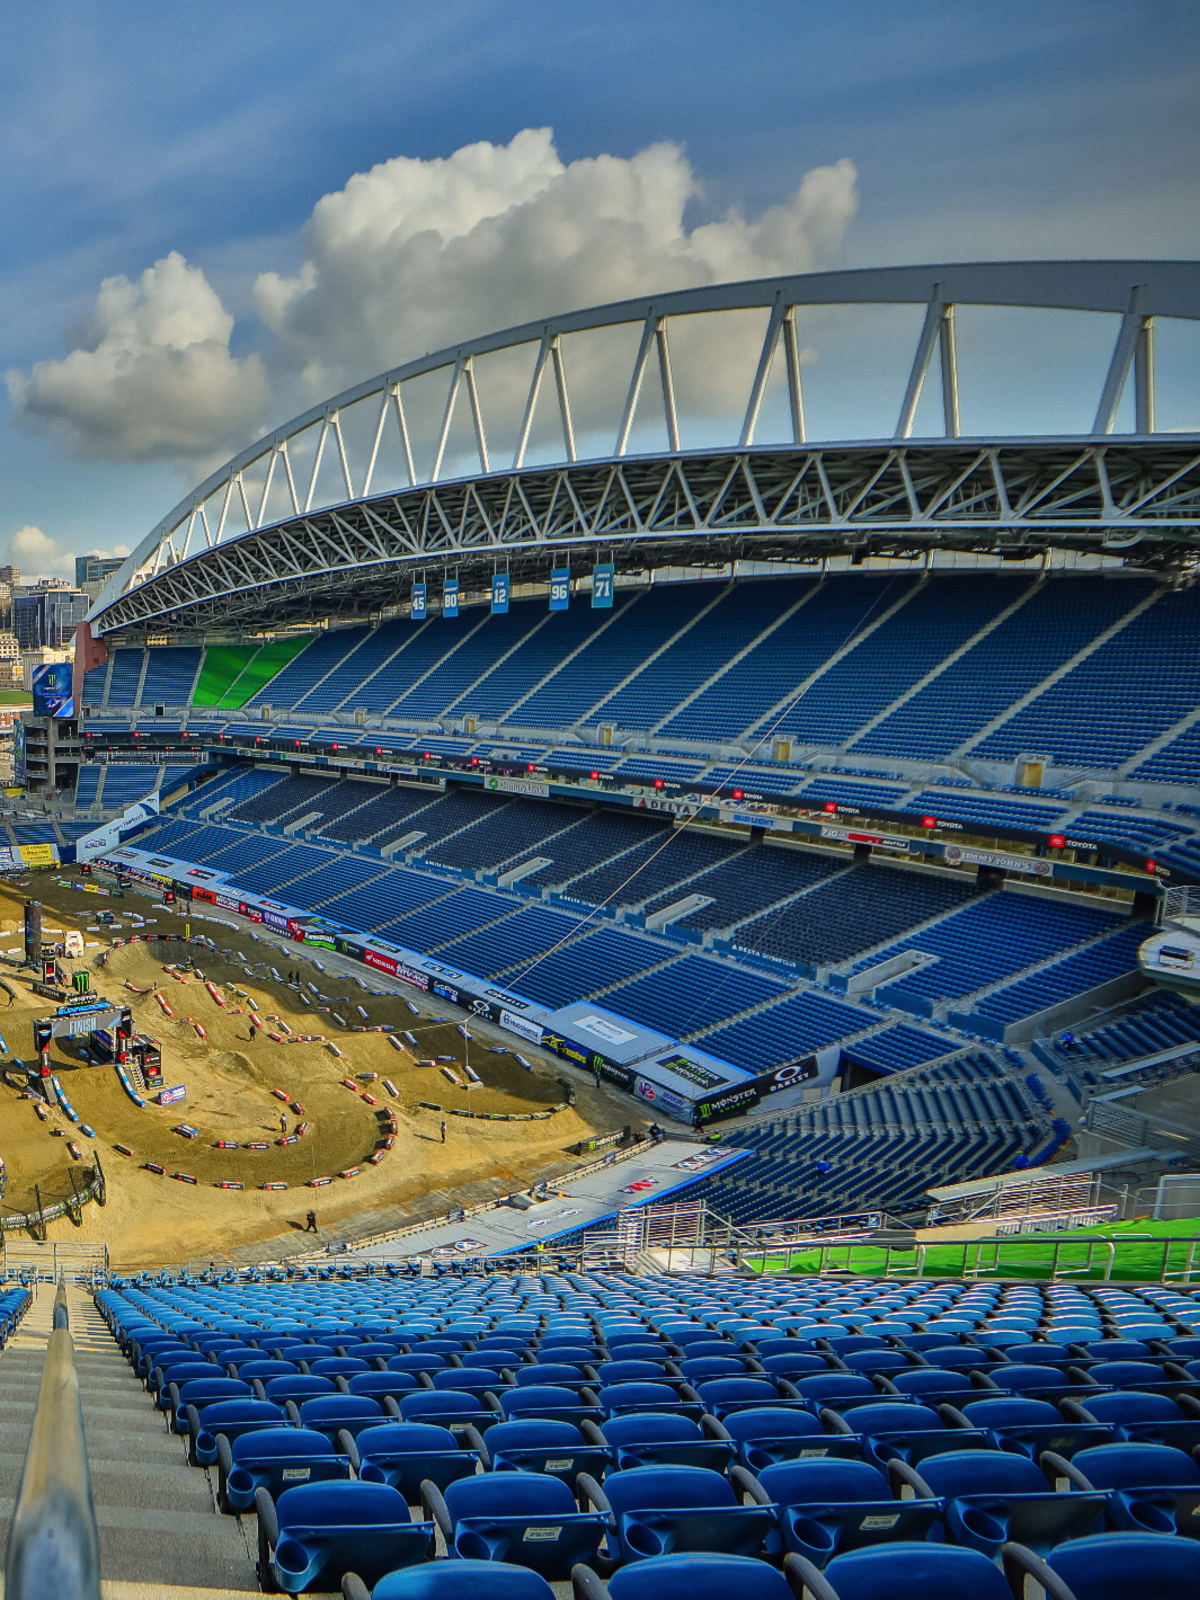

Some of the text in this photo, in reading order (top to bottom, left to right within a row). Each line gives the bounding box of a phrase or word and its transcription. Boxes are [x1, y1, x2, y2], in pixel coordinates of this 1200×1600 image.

[494, 588, 506, 603] 12
[551, 584, 567, 599] 96
[595, 581, 610, 597] 71
[412, 596, 424, 610] 45
[444, 594, 457, 608] 80
[499, 781, 544, 796] CenturyLink
[743, 792, 763, 800] TOYOTA
[651, 800, 691, 814] DELTA
[837, 806, 860, 814] TOYOTA
[733, 814, 775, 826] BUD LIGHT
[937, 821, 963, 830] TOYOTA
[1066, 840, 1097, 850] TOYOTA
[961, 851, 1031, 870] JIMMY JOHN'S
[304, 931, 336, 944] Kawasaki
[738, 945, 761, 957] DELTA
[372, 957, 396, 972] HONDA
[69, 1017, 97, 1034] FINISH
[601, 1062, 629, 1081] MONSTER
[674, 1066, 708, 1086] MONSTER
[686, 1062, 721, 1081] MONSTER
[769, 1071, 810, 1092] OAKLEY
[711, 1087, 757, 1110] MONSTER
[596, 1131, 624, 1146] MONSTER
